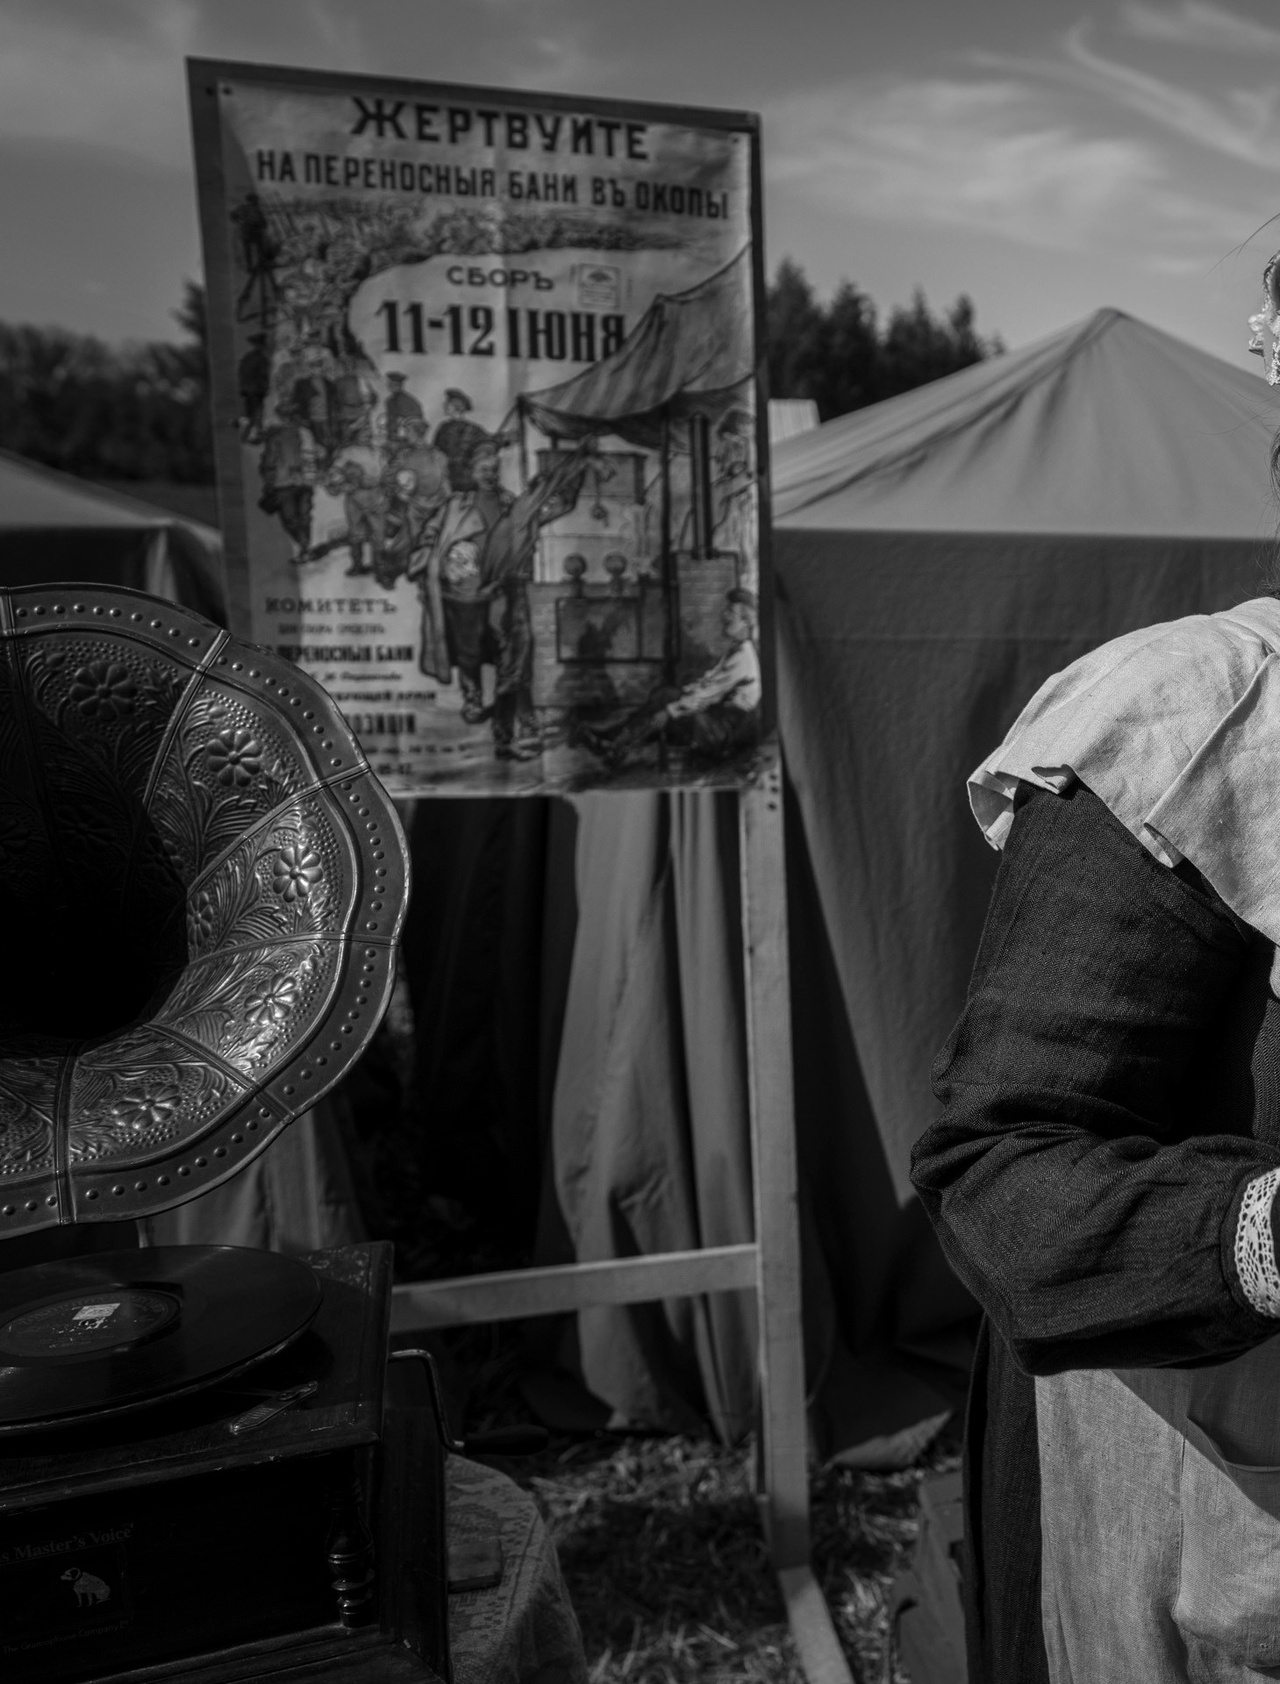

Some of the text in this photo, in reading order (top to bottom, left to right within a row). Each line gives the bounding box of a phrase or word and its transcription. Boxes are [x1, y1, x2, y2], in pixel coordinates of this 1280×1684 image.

[257, 150, 728, 219] НА ПЕРЕНОСНЫЯ БАНИ ВЪ ОКОПЫ
[446, 265, 554, 291] СБОРЪ
[375, 300, 495, 356] 11-12
